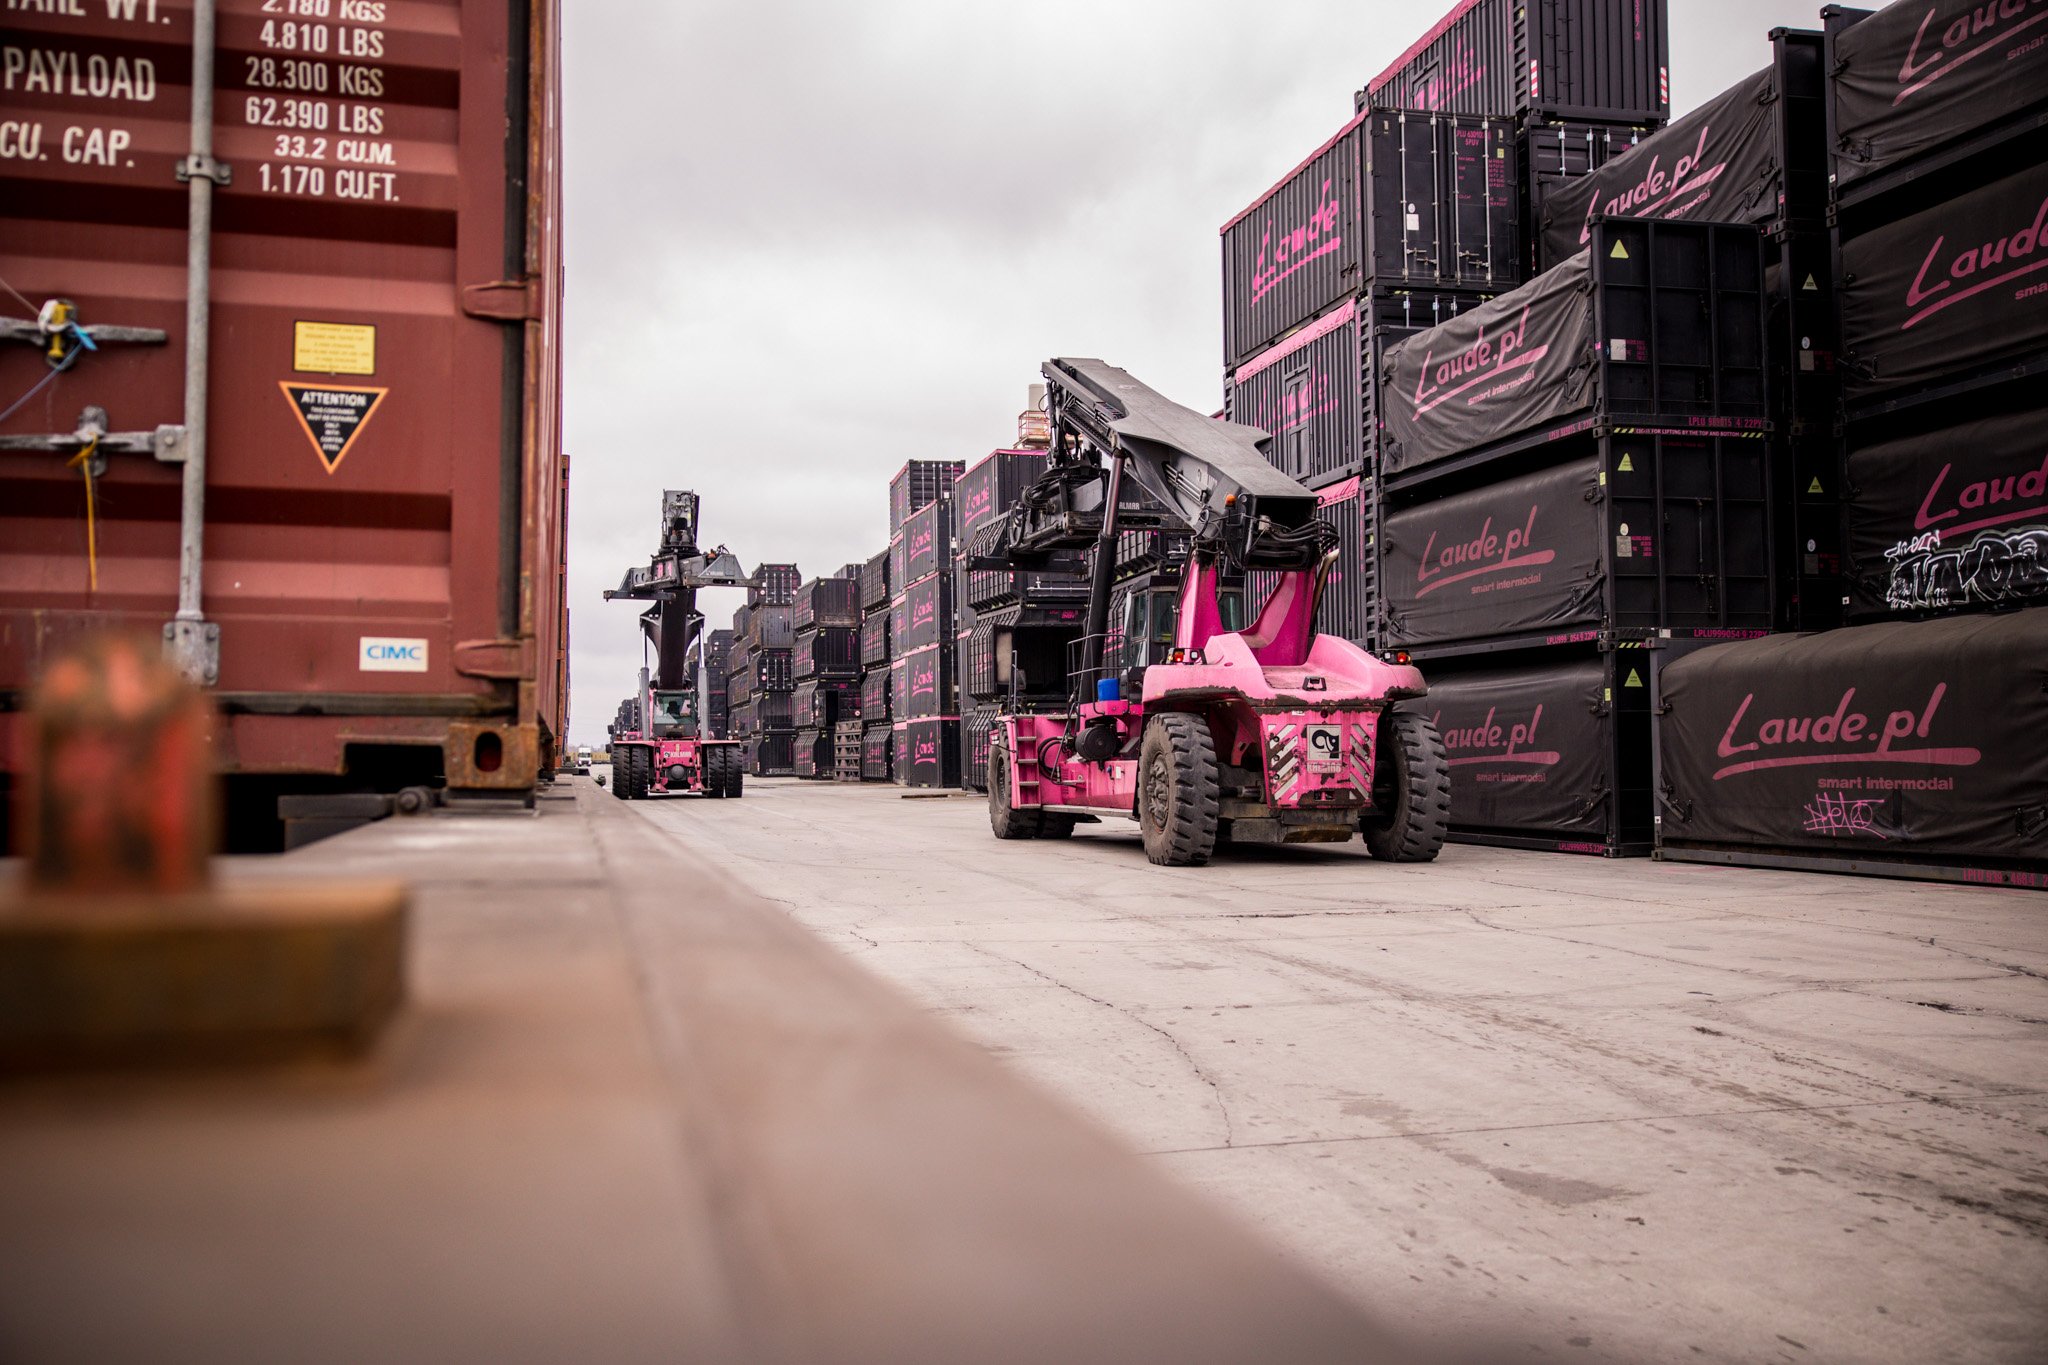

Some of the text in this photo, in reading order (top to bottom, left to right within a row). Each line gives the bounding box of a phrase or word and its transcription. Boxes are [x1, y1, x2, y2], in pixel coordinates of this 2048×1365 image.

[339, 0, 386, 22] KGS
[260, 19, 384, 58] 4.810 LBS
[1898, 0, 2043, 83] Lau
[3, 46, 156, 101] PAYLOAD
[245, 56, 384, 96] 28.300 KGS
[245, 96, 384, 134] 62.390 LBS
[0, 121, 135, 168] CU. CAP.
[274, 134, 397, 166] 33.2 CU.M.
[259, 163, 399, 201] 1.170 CU.FT.
[1253, 178, 1339, 291] Laude
[1415, 304, 1530, 404] Laude.pl
[301, 391, 367, 407] ATTENTION
[1468, 370, 1535, 406] smart intermodal
[1418, 505, 1537, 582] Laude.pl
[1471, 573, 1541, 594] smart intermodal
[367, 645, 422, 661] CIMC
[1433, 704, 1542, 757] aude.pl
[1717, 682, 1947, 757] Laude.pl
[1476, 772, 1546, 782] smart intermodal
[1817, 777, 1953, 791] smart intermodal
